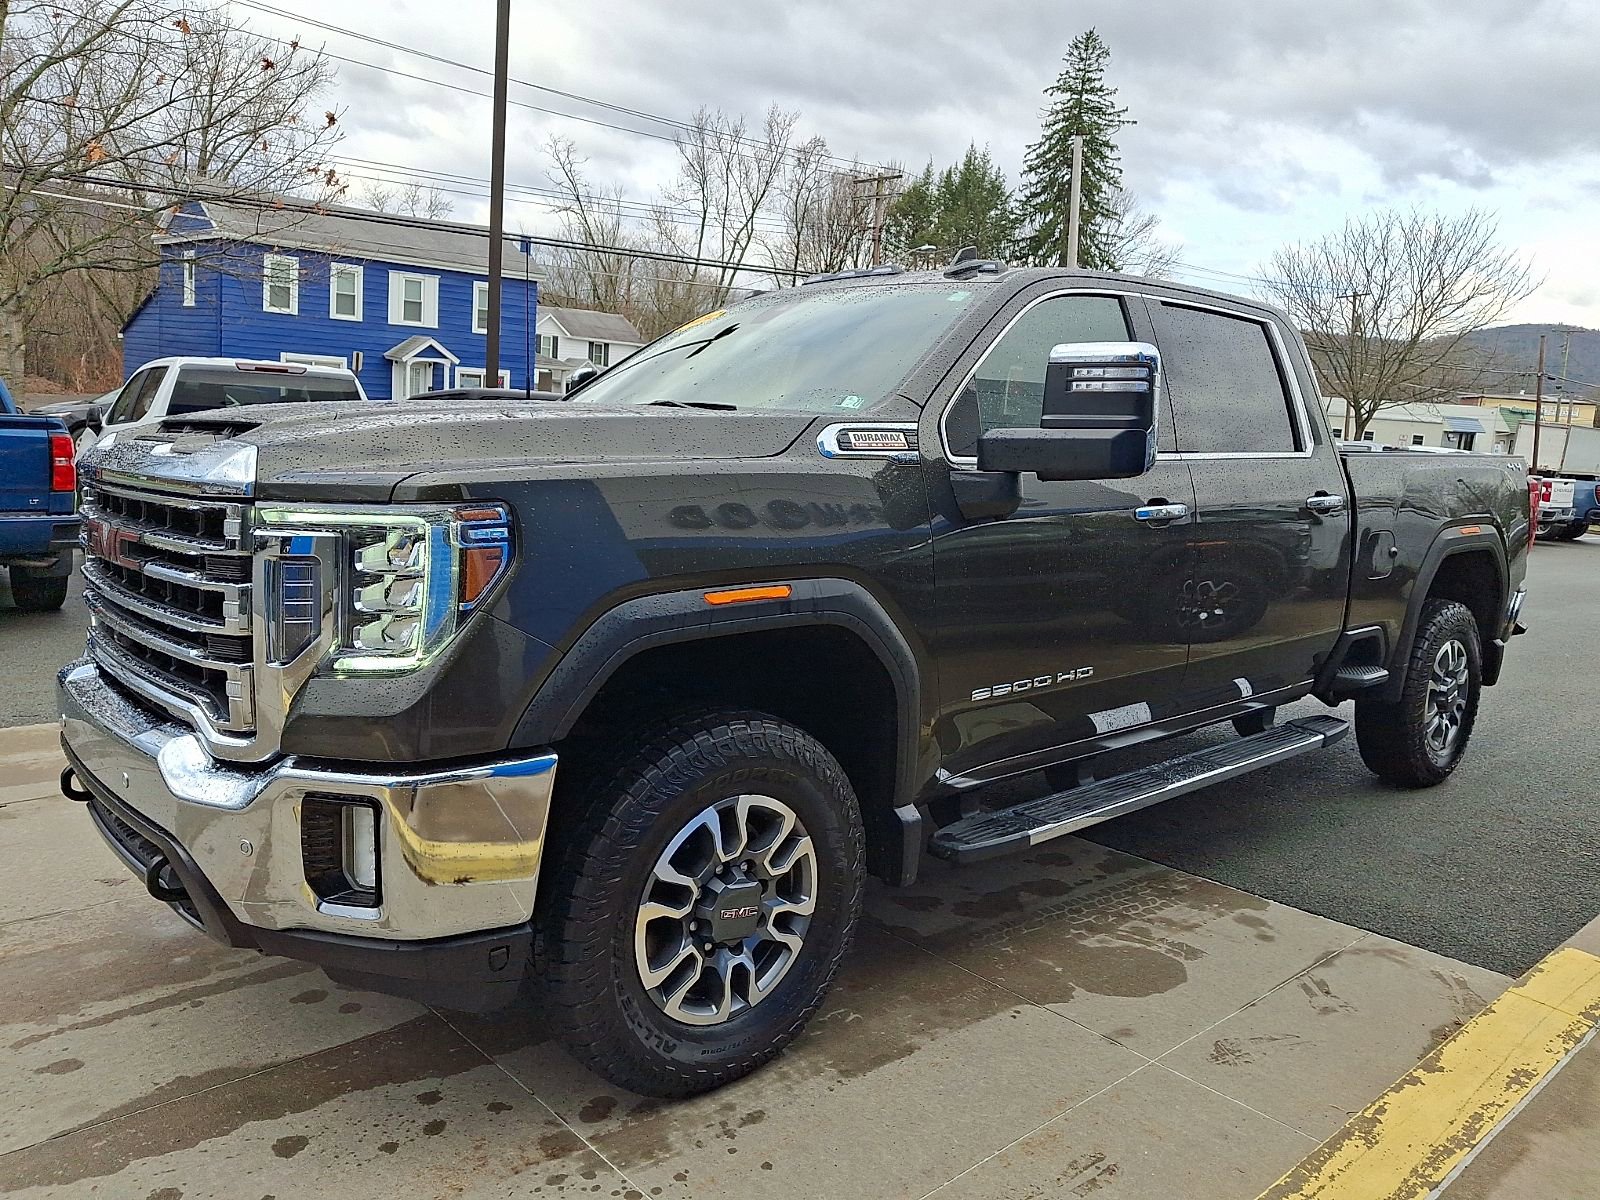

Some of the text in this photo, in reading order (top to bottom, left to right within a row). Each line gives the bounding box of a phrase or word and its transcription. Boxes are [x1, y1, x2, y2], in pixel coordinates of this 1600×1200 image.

[853, 433, 903, 442] DURAMAX
[1056, 666, 1094, 684] HD
[720, 905, 759, 920] GMC
